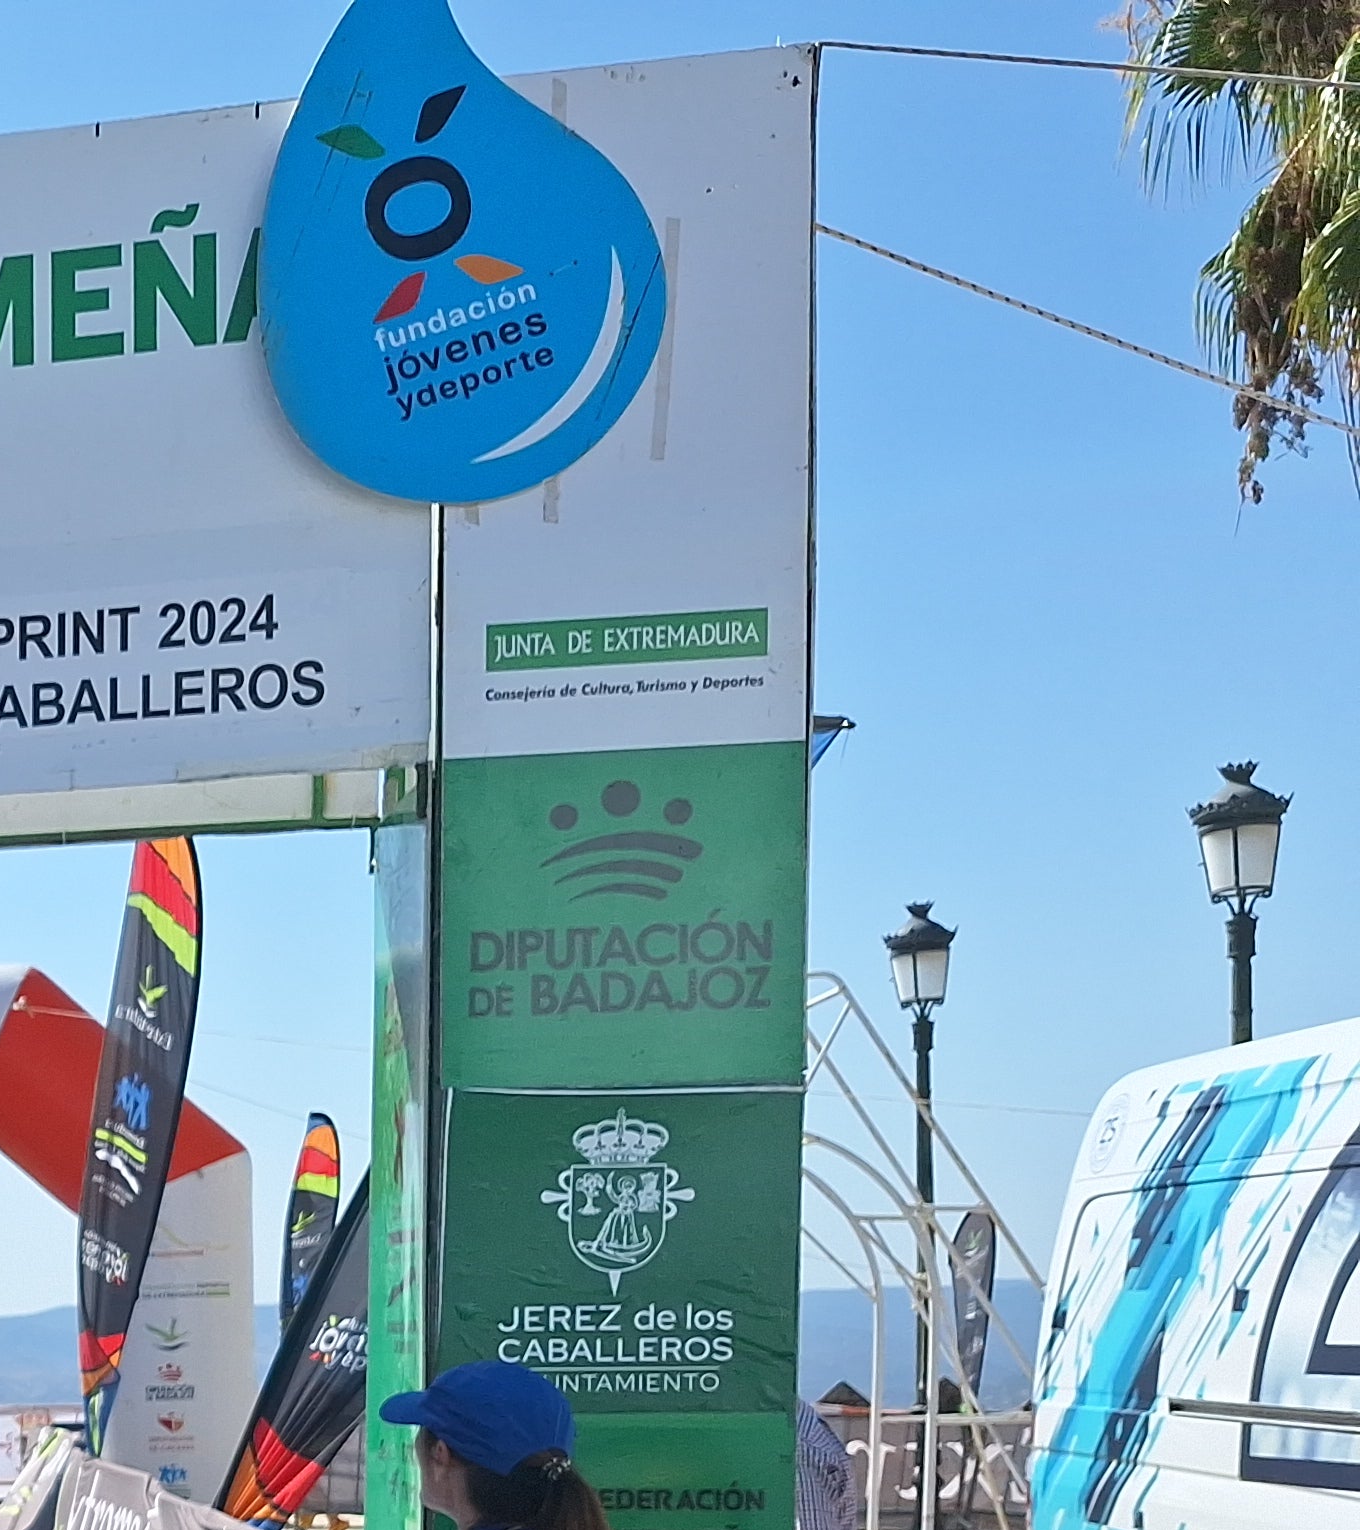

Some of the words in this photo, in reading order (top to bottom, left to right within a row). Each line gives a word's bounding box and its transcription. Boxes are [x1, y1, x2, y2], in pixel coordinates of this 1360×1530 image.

[373, 282, 538, 352] fundación
[383, 311, 549, 395] jóvenes
[394, 346, 555, 422] ydeporte
[158, 593, 279, 650] 2024
[493, 631, 556, 663] JUNTA
[567, 630, 593, 655] DE
[603, 620, 761, 653] EXTREMADURA
[484, 683, 556, 703] Consejería
[559, 682, 578, 698] de
[580, 680, 635, 698] Cultura,
[636, 678, 687, 694] Turismo
[690, 681, 699, 693] y
[702, 674, 765, 690] Deportes
[468, 908, 775, 974] DIPUTACIÓN
[468, 984, 515, 1017] DE
[530, 965, 772, 1016] BADAJOZ
[497, 1303, 621, 1333] JEREZ
[633, 1302, 677, 1331] de
[685, 1302, 734, 1331] los
[497, 1335, 734, 1364] CABALLEROS
[600, 1480, 766, 1511] EDERACIÓN
